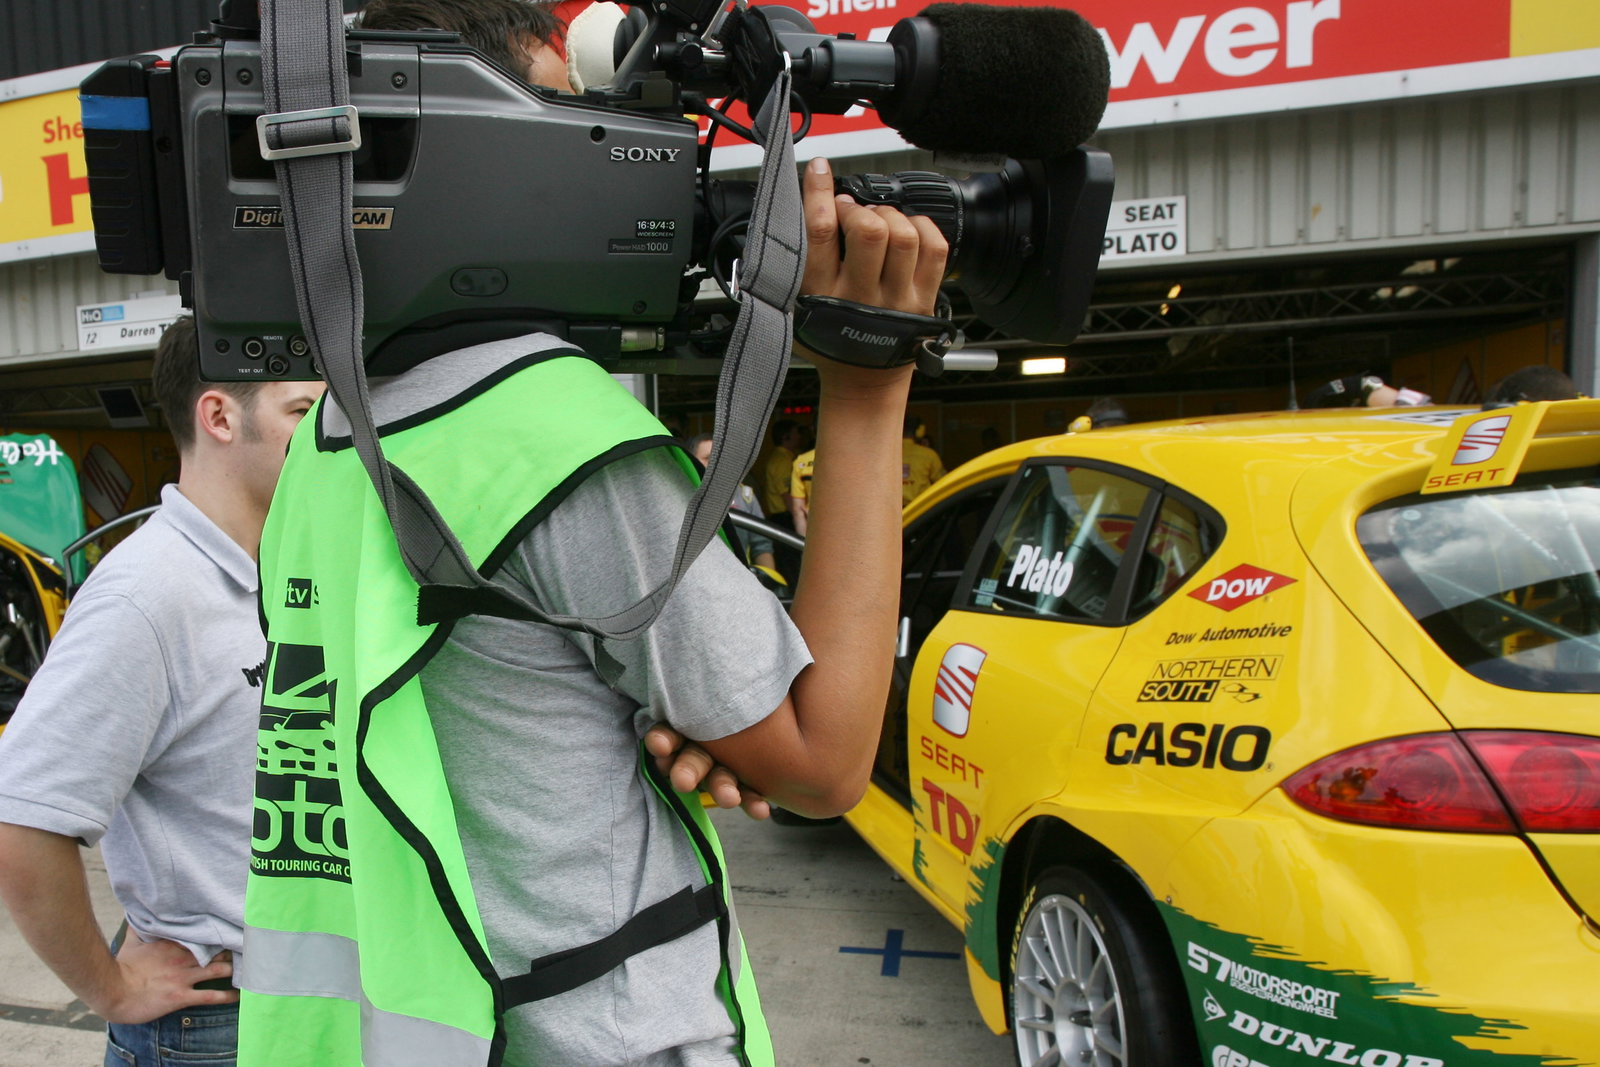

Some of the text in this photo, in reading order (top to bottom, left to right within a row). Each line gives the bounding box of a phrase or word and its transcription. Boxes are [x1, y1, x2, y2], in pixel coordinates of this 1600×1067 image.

[610, 147, 680, 161] SONY
[1125, 203, 1177, 222] SEAT
[637, 221, 675, 230] 16:9/4:3
[647, 242, 669, 251] 1000
[1101, 231, 1177, 255] PLATO
[120, 326, 156, 339] Darren
[841, 326, 898, 347] FUJINON
[1426, 468, 1505, 488] SEAT
[1007, 544, 1074, 598] Plato
[1206, 576, 1274, 602] DOW
[1165, 622, 1293, 645] Dow Automotive
[1152, 658, 1278, 680] NORTHERN
[1139, 681, 1218, 701] SOUTH
[1104, 722, 1272, 772] CASIO
[921, 735, 984, 789] SEAT
[270, 859, 320, 871] TOURING
[322, 862, 342, 876] CAR
[1230, 961, 1341, 1010] MOTORSPORT
